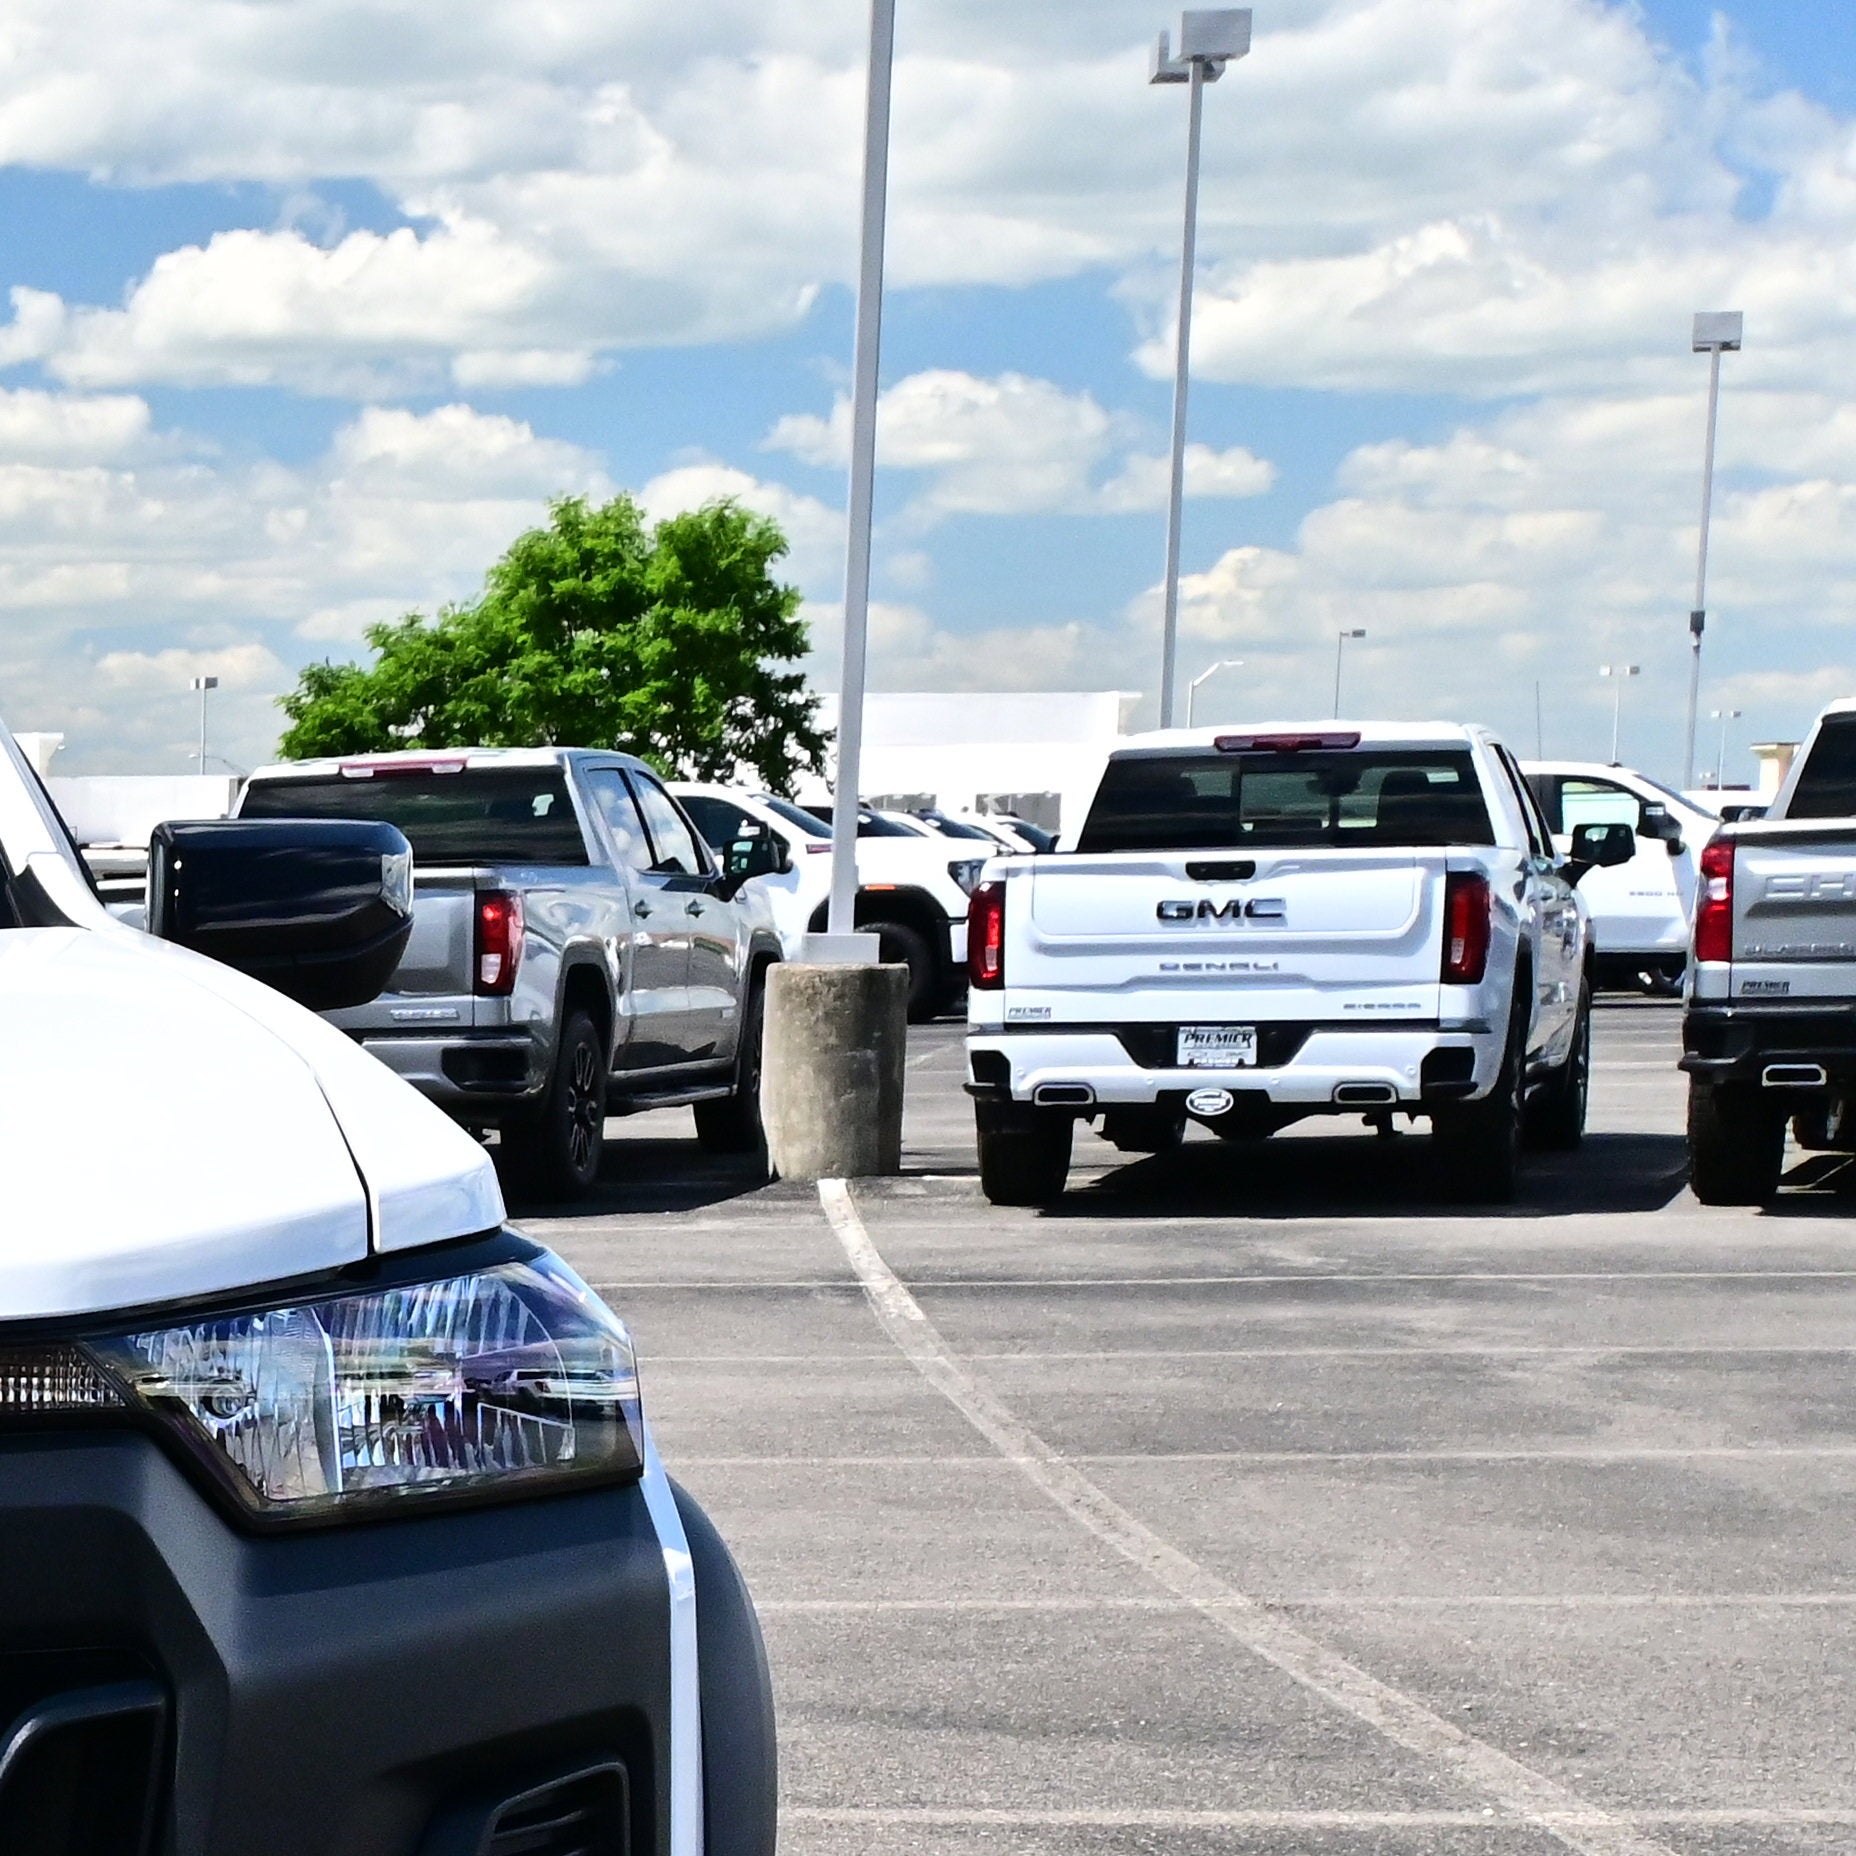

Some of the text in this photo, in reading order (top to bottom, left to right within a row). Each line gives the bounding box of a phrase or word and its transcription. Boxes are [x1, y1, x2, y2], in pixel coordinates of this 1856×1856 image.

[1156, 898, 1287, 927] GMC
[1159, 962, 1279, 971] DENALI
[1183, 1029, 1253, 1049] PREMIER
